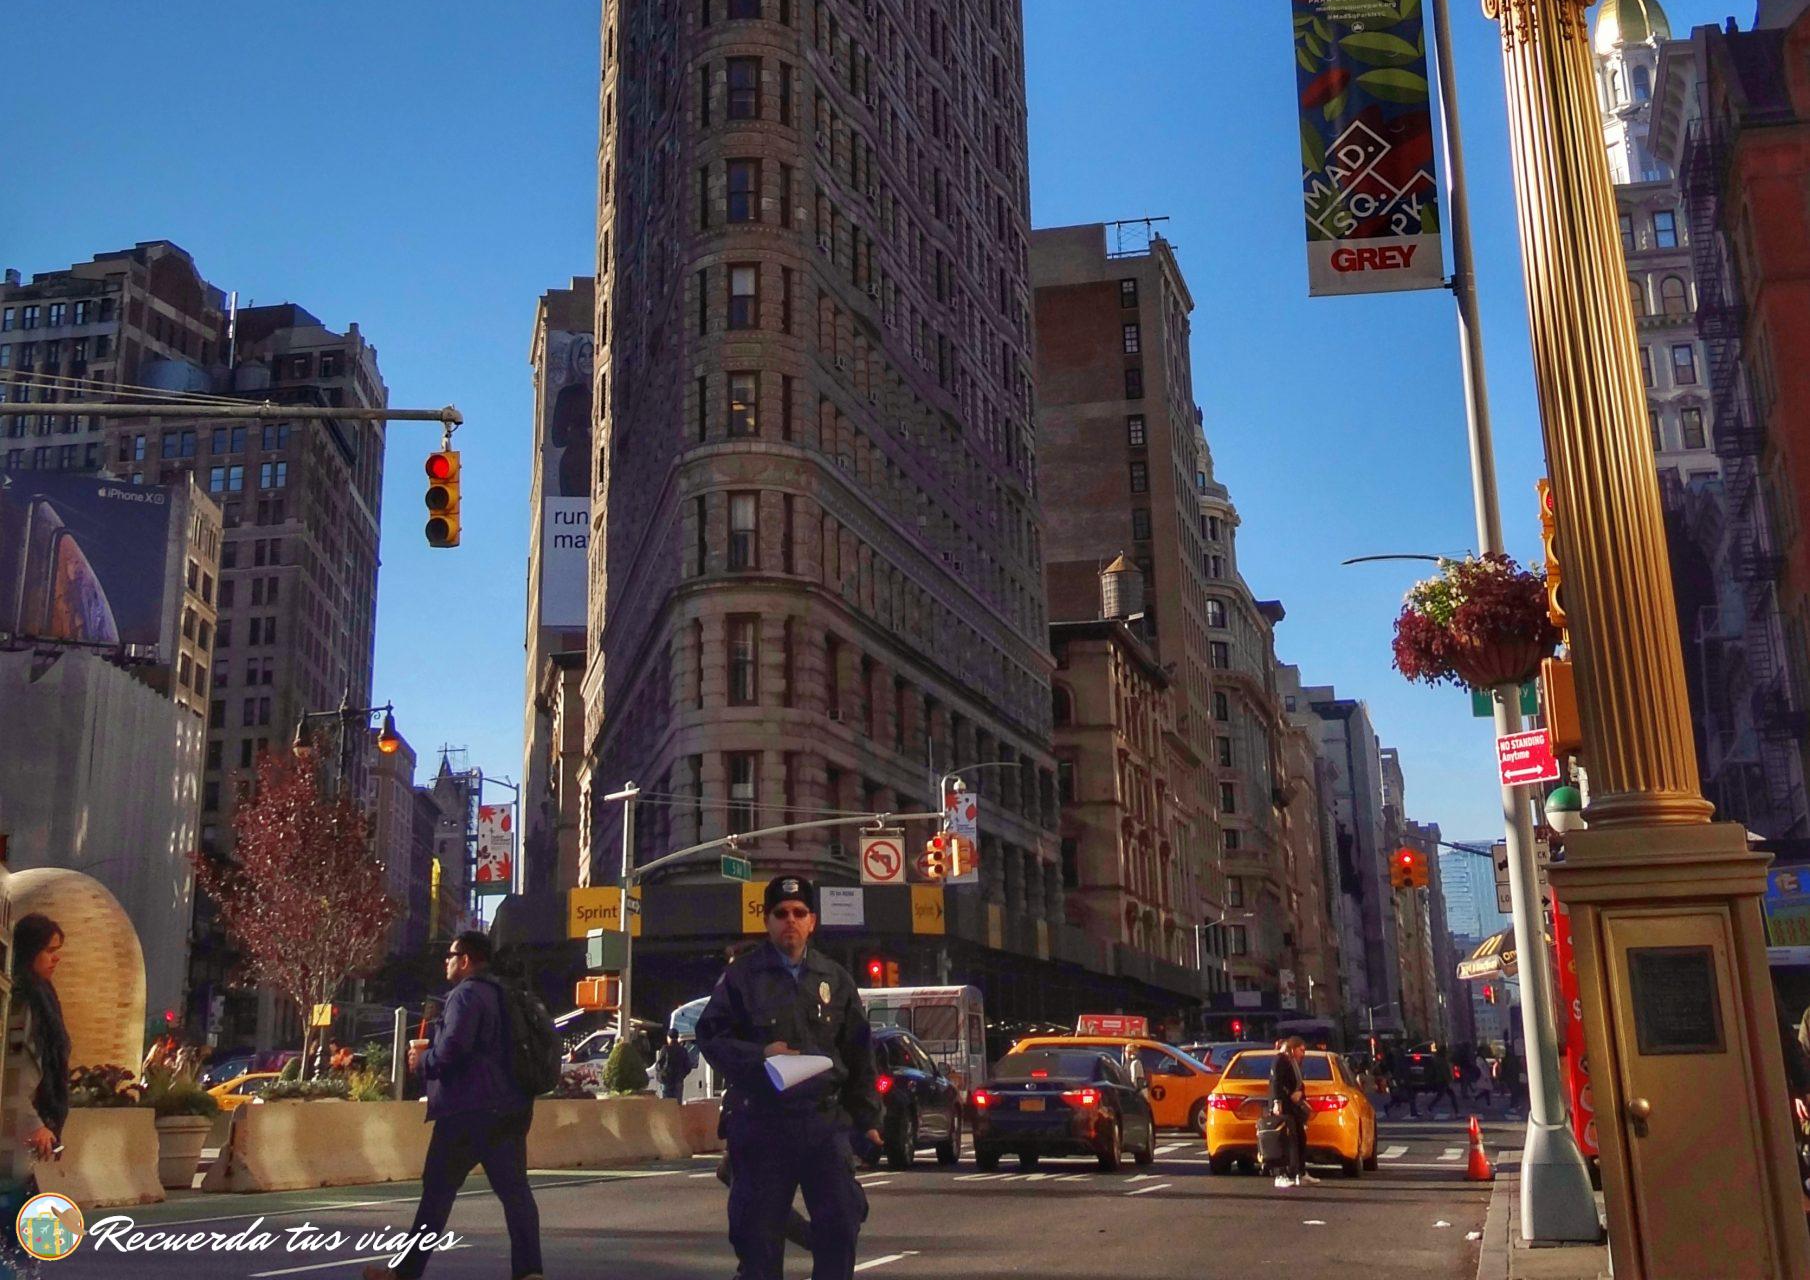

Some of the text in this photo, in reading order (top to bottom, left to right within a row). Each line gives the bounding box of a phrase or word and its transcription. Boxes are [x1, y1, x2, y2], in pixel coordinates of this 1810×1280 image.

[1304, 145, 1375, 209] MAD.
[1333, 193, 1387, 236] SQ.
[1330, 244, 1418, 273] GREY
[107, 488, 144, 502] iPhone
[554, 534, 590, 549] ma
[1500, 735, 1545, 751] NO STANDING
[1502, 750, 1530, 763] Anytime
[576, 905, 617, 923] Sprint
